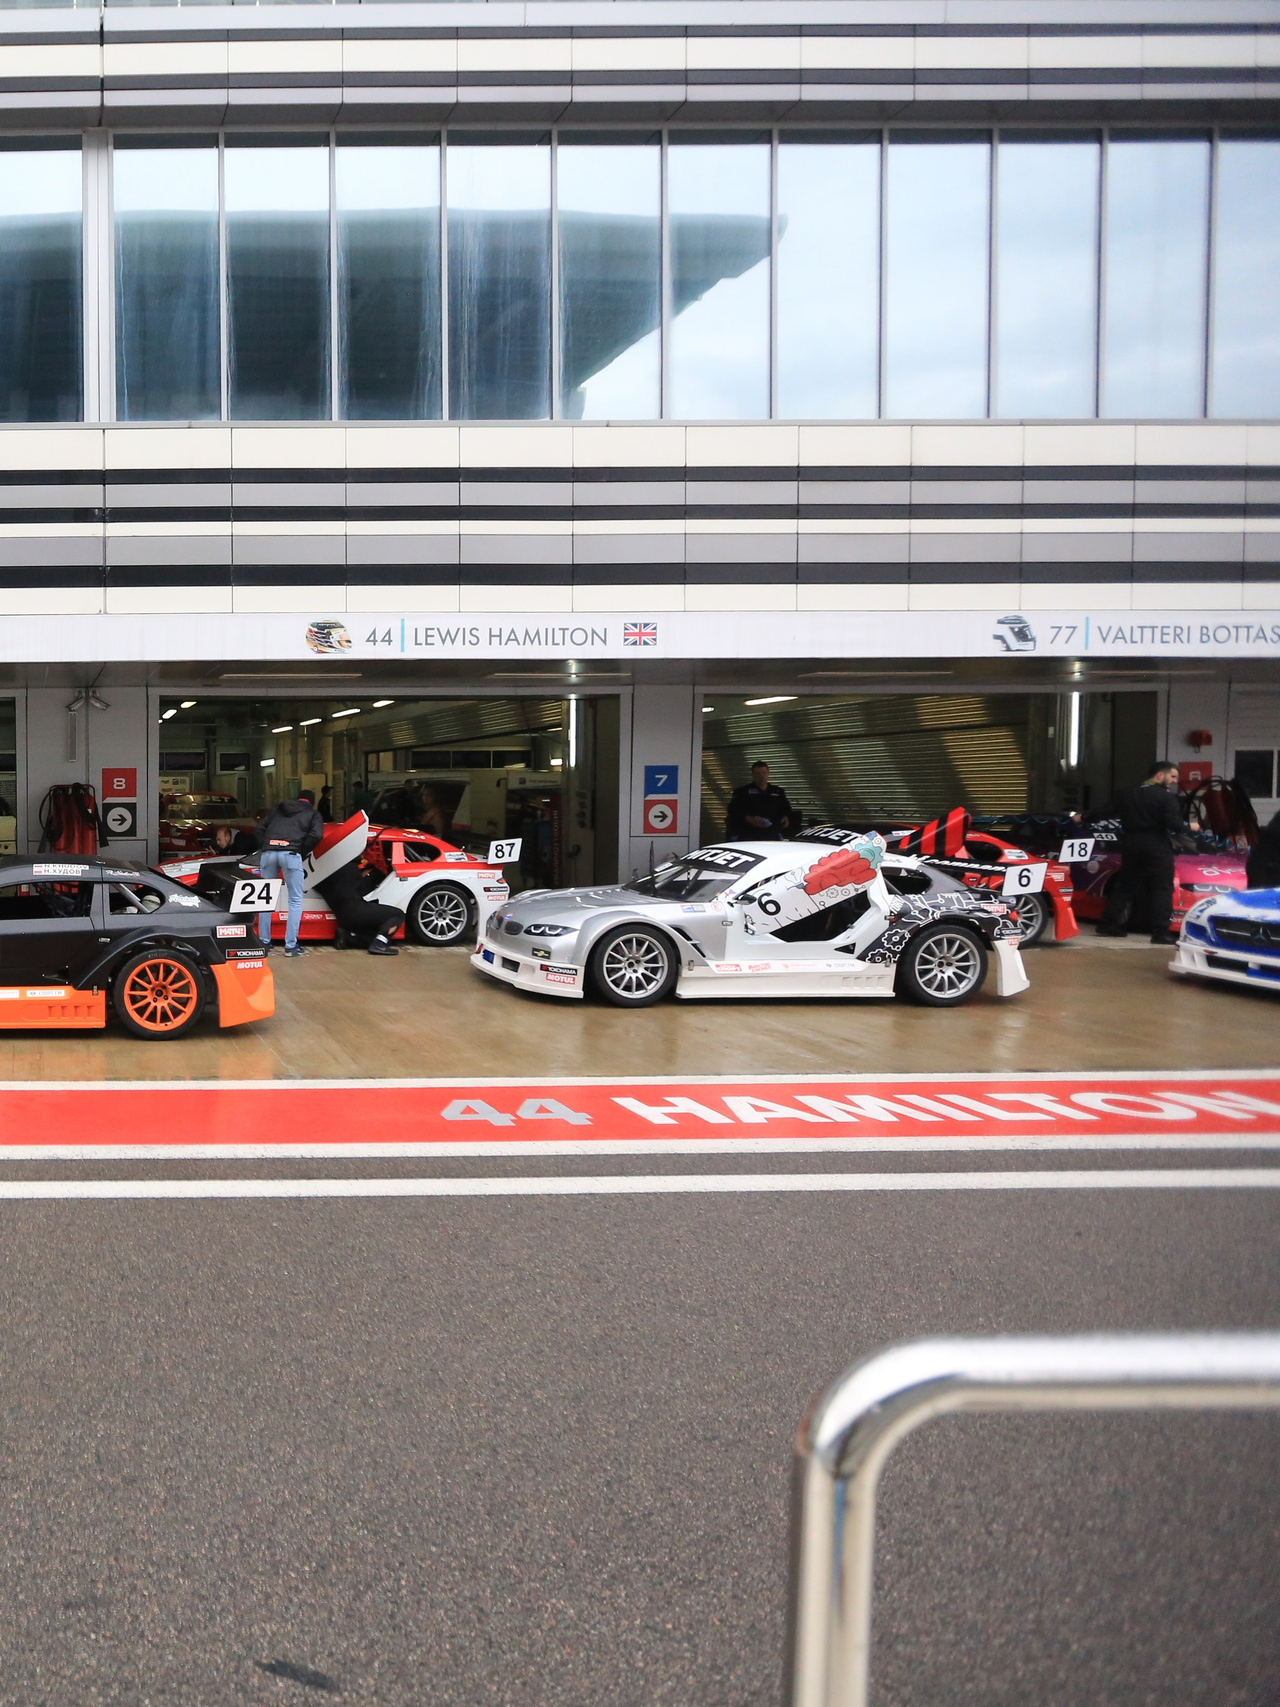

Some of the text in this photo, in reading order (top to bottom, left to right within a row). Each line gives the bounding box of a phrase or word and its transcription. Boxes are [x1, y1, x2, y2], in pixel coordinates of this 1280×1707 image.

[365, 627, 608, 647] 44 LEWIS HAMILTON
[1050, 625, 1280, 645] 77 VALTTERI BOTTAS
[113, 777, 126, 790] 8
[655, 774, 668, 787] 7
[494, 842, 516, 859] 87
[1067, 841, 1088, 857] 18
[680, 849, 756, 869] MITJET
[1017, 868, 1031, 888] 6
[240, 882, 273, 905] 24
[758, 892, 782, 916] 6
[236, 961, 263, 969] MOTUL
[548, 966, 577, 975] YOKOHAMA
[547, 974, 576, 984] MOTUL
[440, 1092, 1280, 1126] 44 HAMILTON
